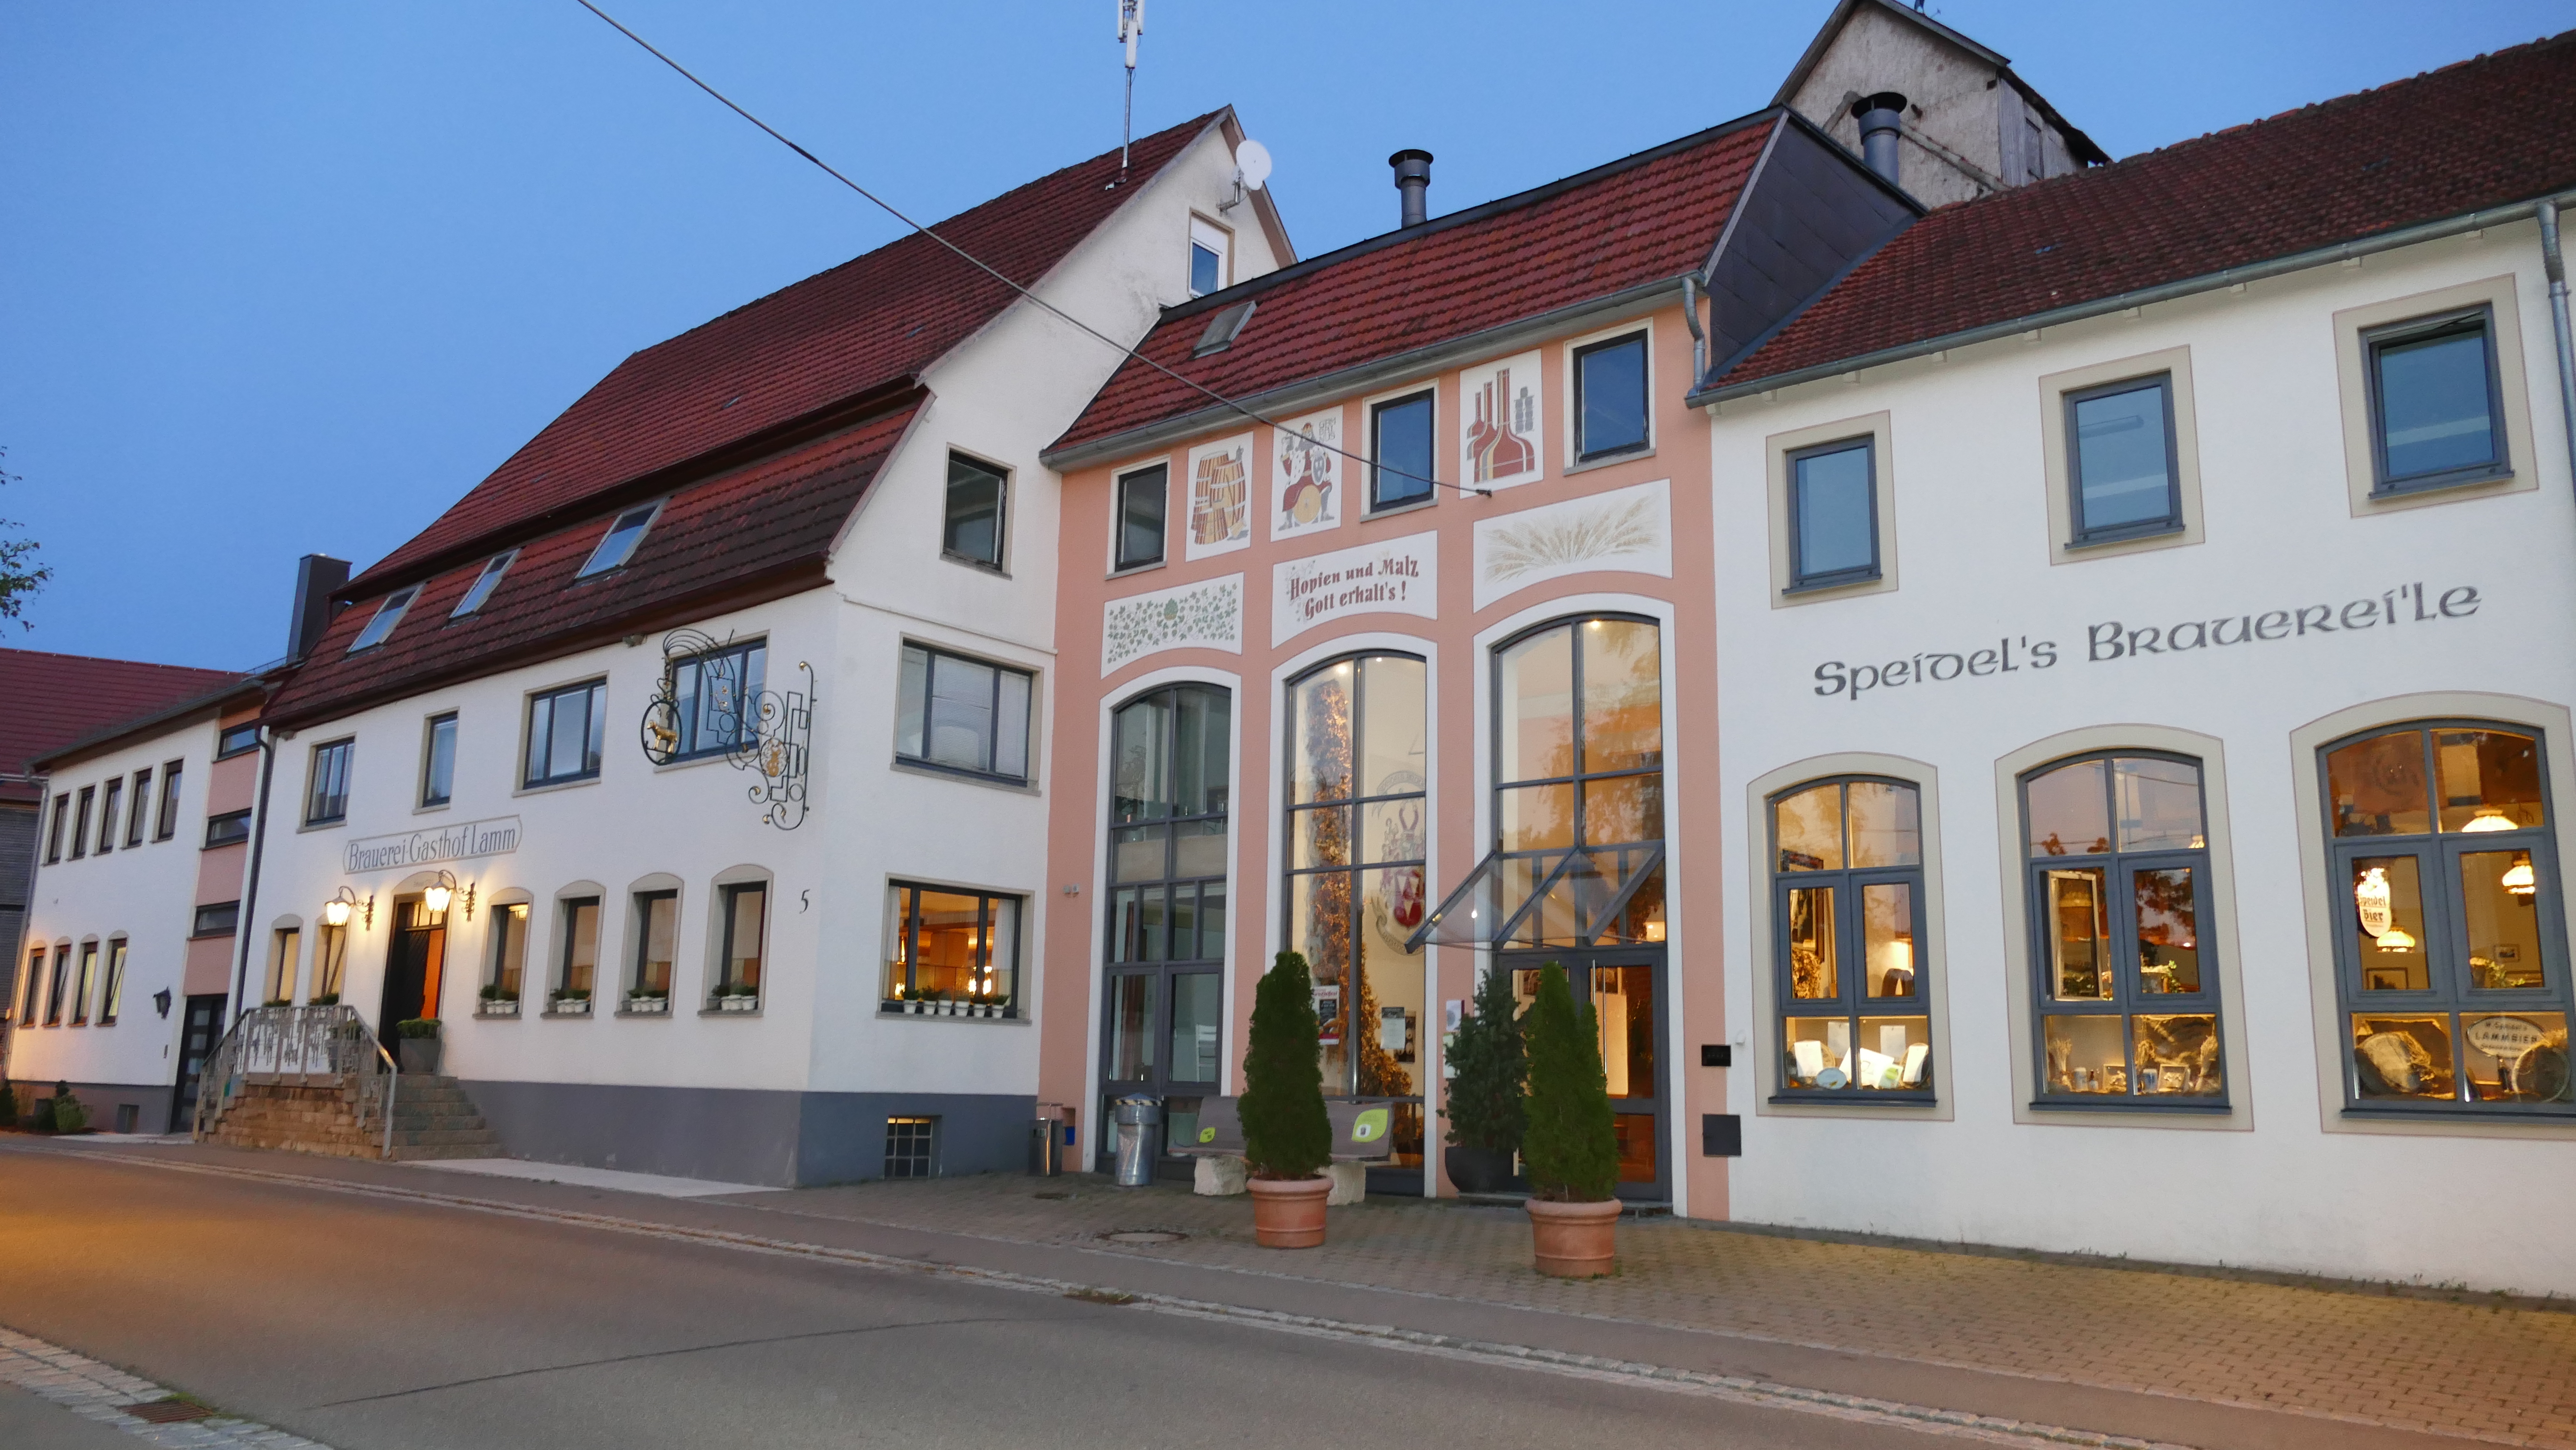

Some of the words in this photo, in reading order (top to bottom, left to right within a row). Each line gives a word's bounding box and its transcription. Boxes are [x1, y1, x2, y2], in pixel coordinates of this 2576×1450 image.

[1346, 562, 1373, 580] und
[1378, 555, 1419, 578] Malz
[1304, 593, 1335, 620] Gott
[1814, 635, 2058, 701] Speidel's
[471, 825, 515, 855] Lamm
[799, 889, 810, 914] 5
[2363, 909, 2383, 921] Bier
